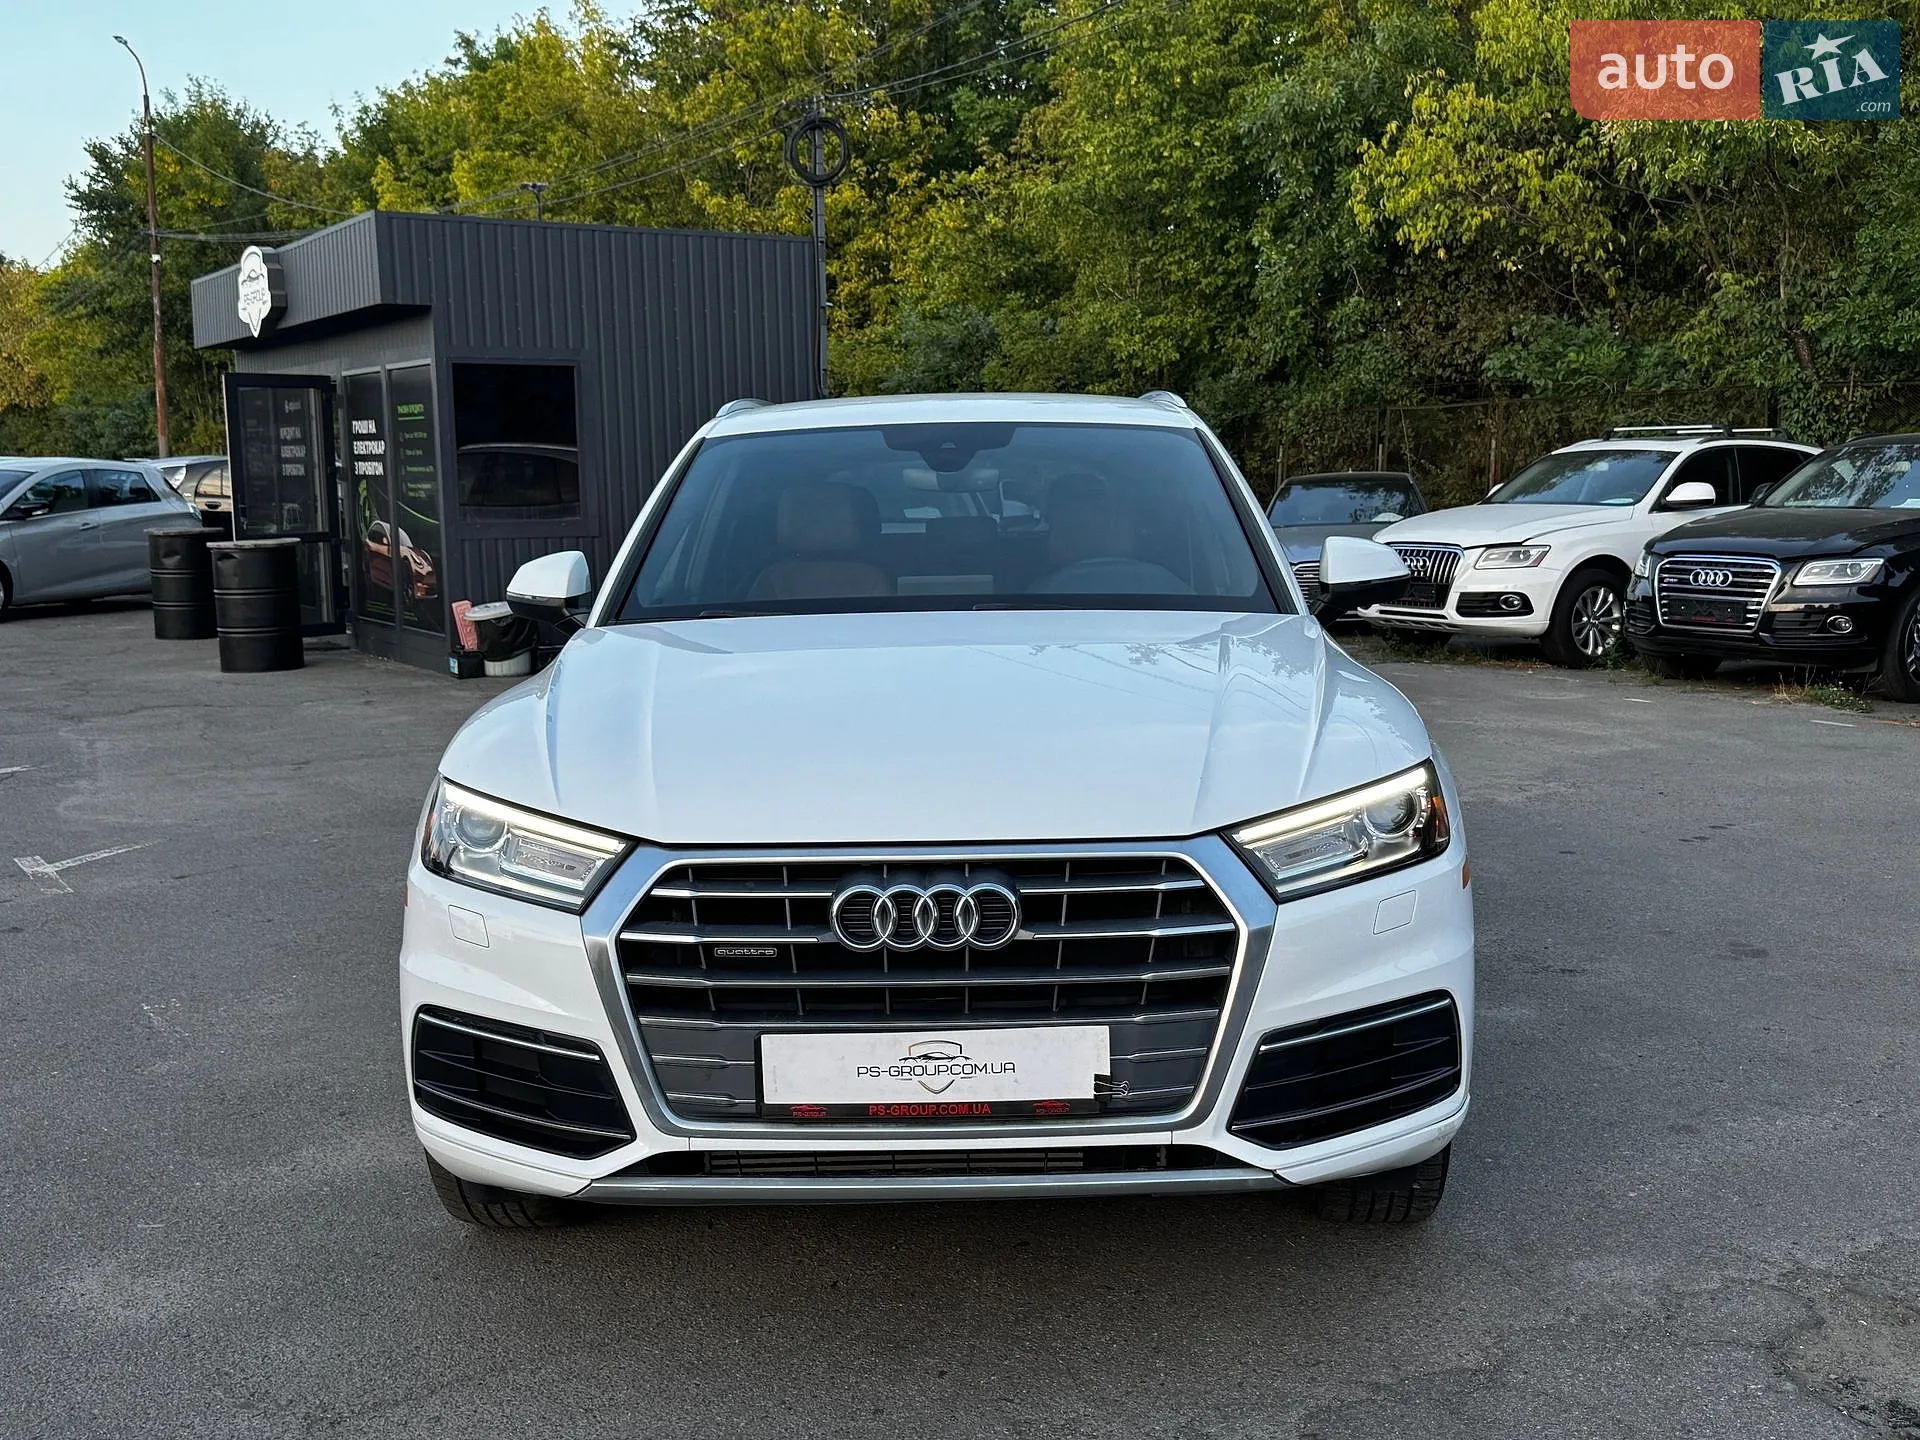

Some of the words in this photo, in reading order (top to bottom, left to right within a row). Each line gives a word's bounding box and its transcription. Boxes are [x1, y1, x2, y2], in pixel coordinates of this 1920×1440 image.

[368, 419, 377, 433] НА
[353, 440, 386, 455] ЕЛЕКТРОКАР
[358, 461, 384, 475] ПРОБІГОМ
[716, 948, 775, 957] quattro
[868, 1103, 991, 1116] PS-GROUP.COM.UA
